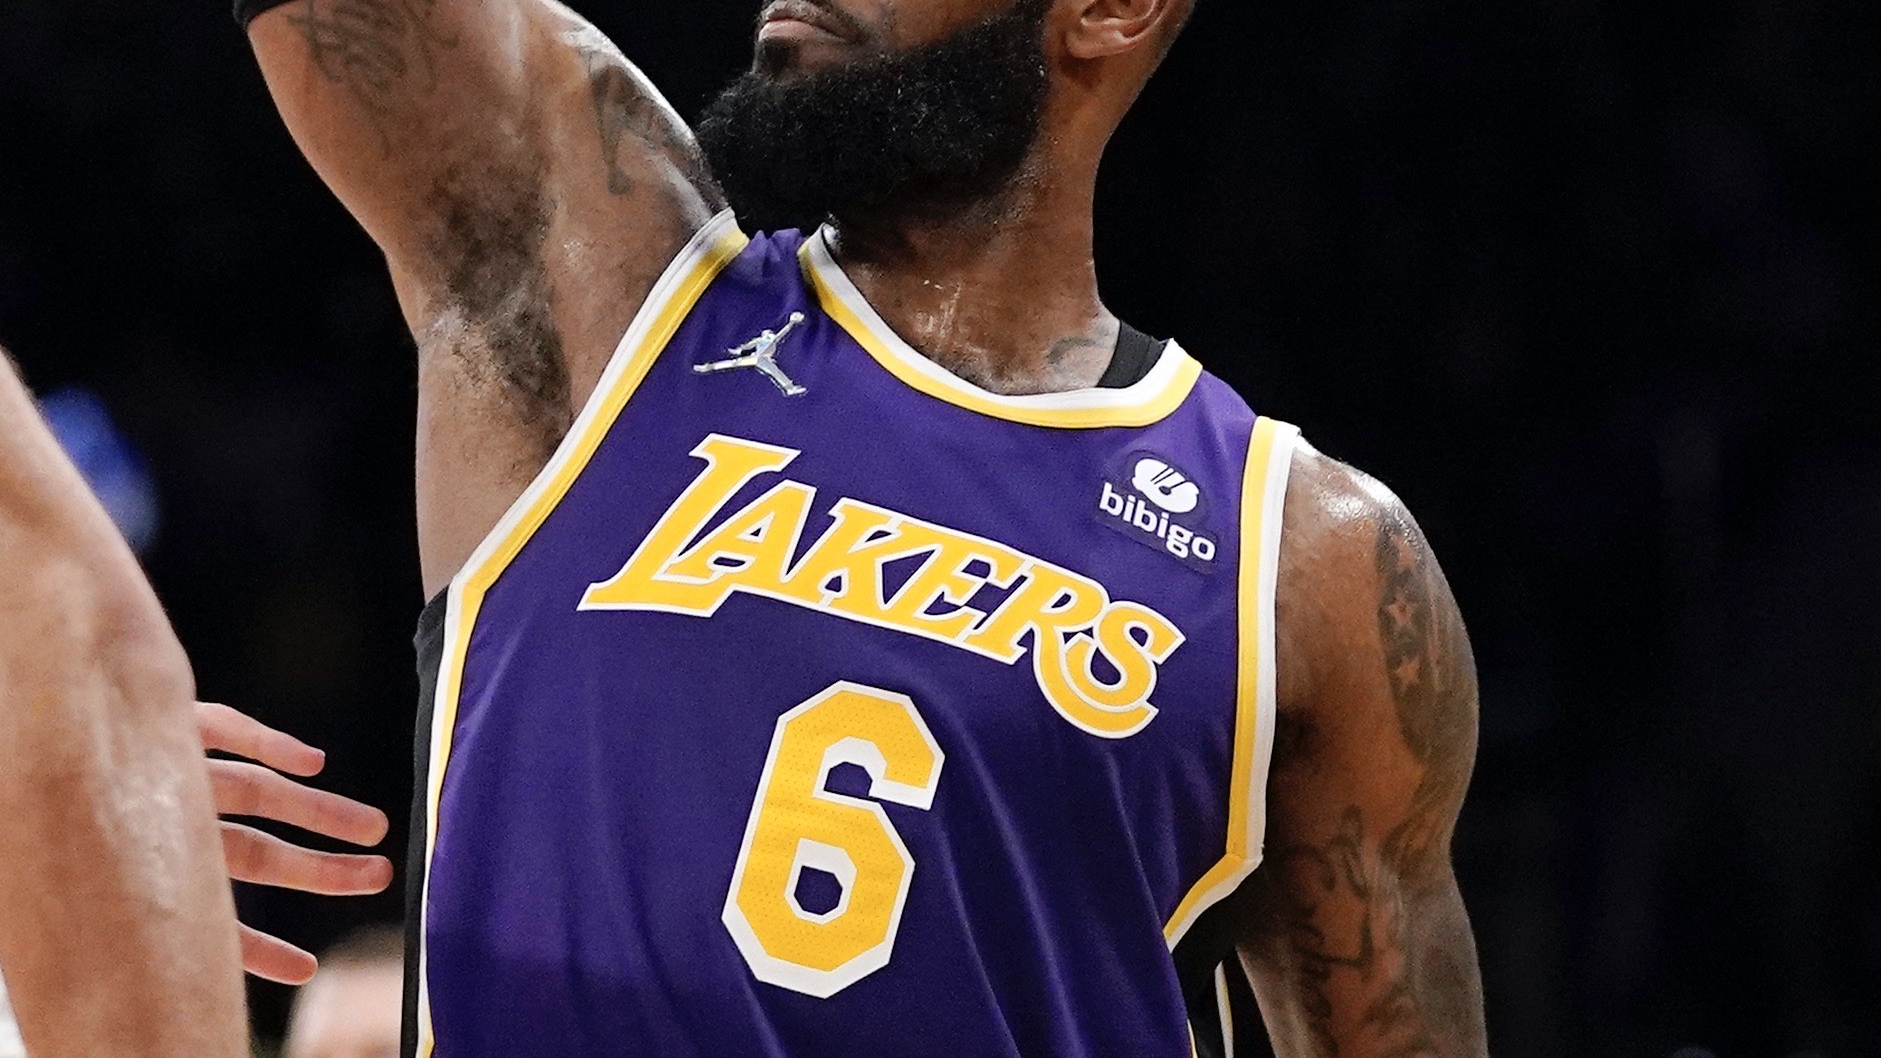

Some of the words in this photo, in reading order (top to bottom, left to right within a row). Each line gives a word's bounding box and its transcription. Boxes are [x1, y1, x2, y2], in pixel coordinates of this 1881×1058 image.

[577, 433, 1186, 739] LAKERS
[1099, 482, 1216, 561] bibigo
[721, 680, 945, 999] 6
